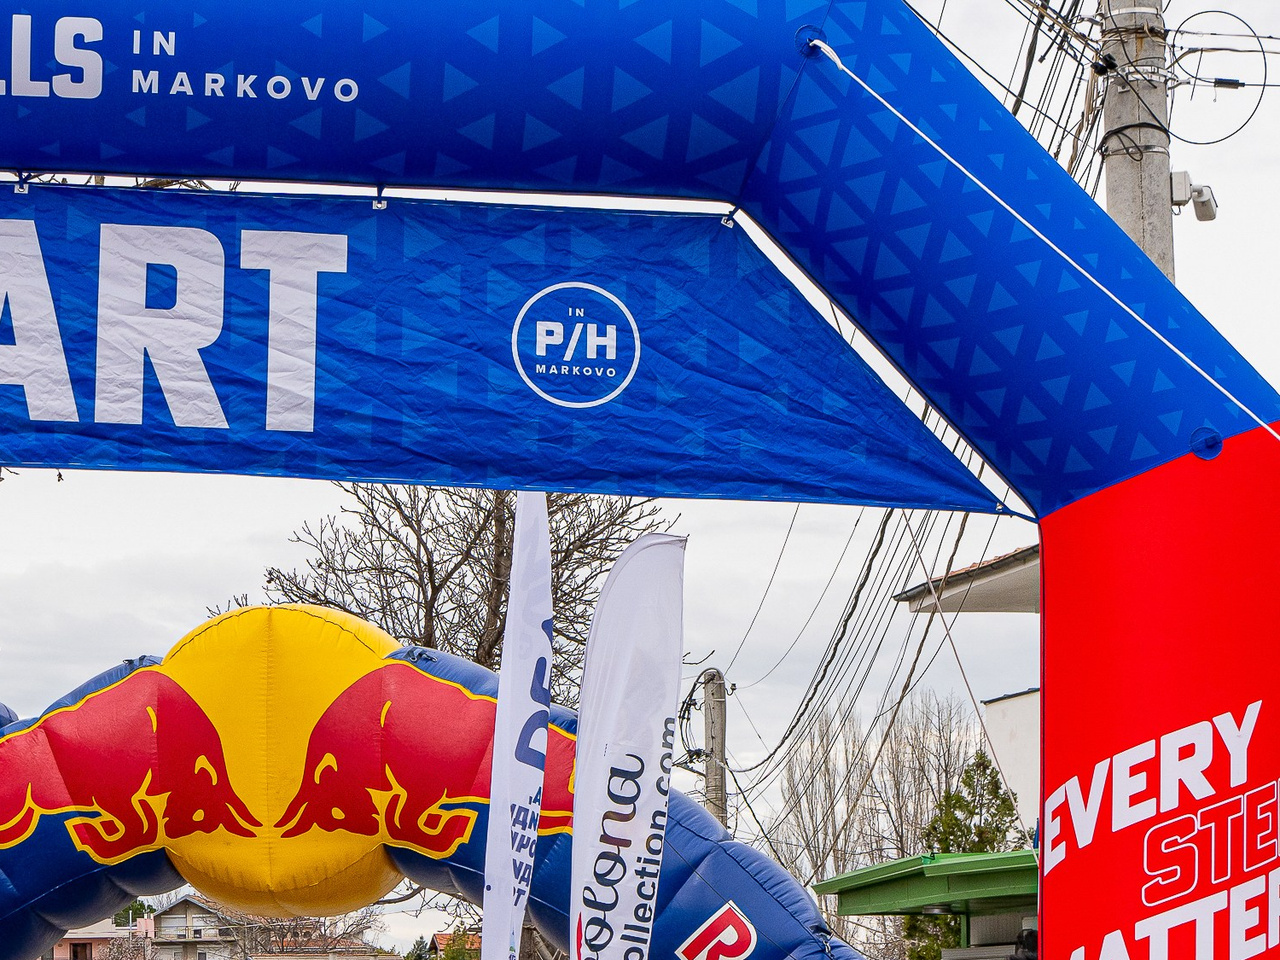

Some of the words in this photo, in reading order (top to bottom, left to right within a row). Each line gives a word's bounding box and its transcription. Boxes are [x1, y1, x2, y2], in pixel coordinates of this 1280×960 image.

[132, 29, 176, 57] IN
[131, 69, 360, 103] MARKOVO
[568, 307, 585, 317] IN
[535, 320, 617, 362] P/H
[535, 364, 616, 378] MARKOVO
[1044, 700, 1263, 877] EVERY
[1141, 777, 1280, 907] STE
